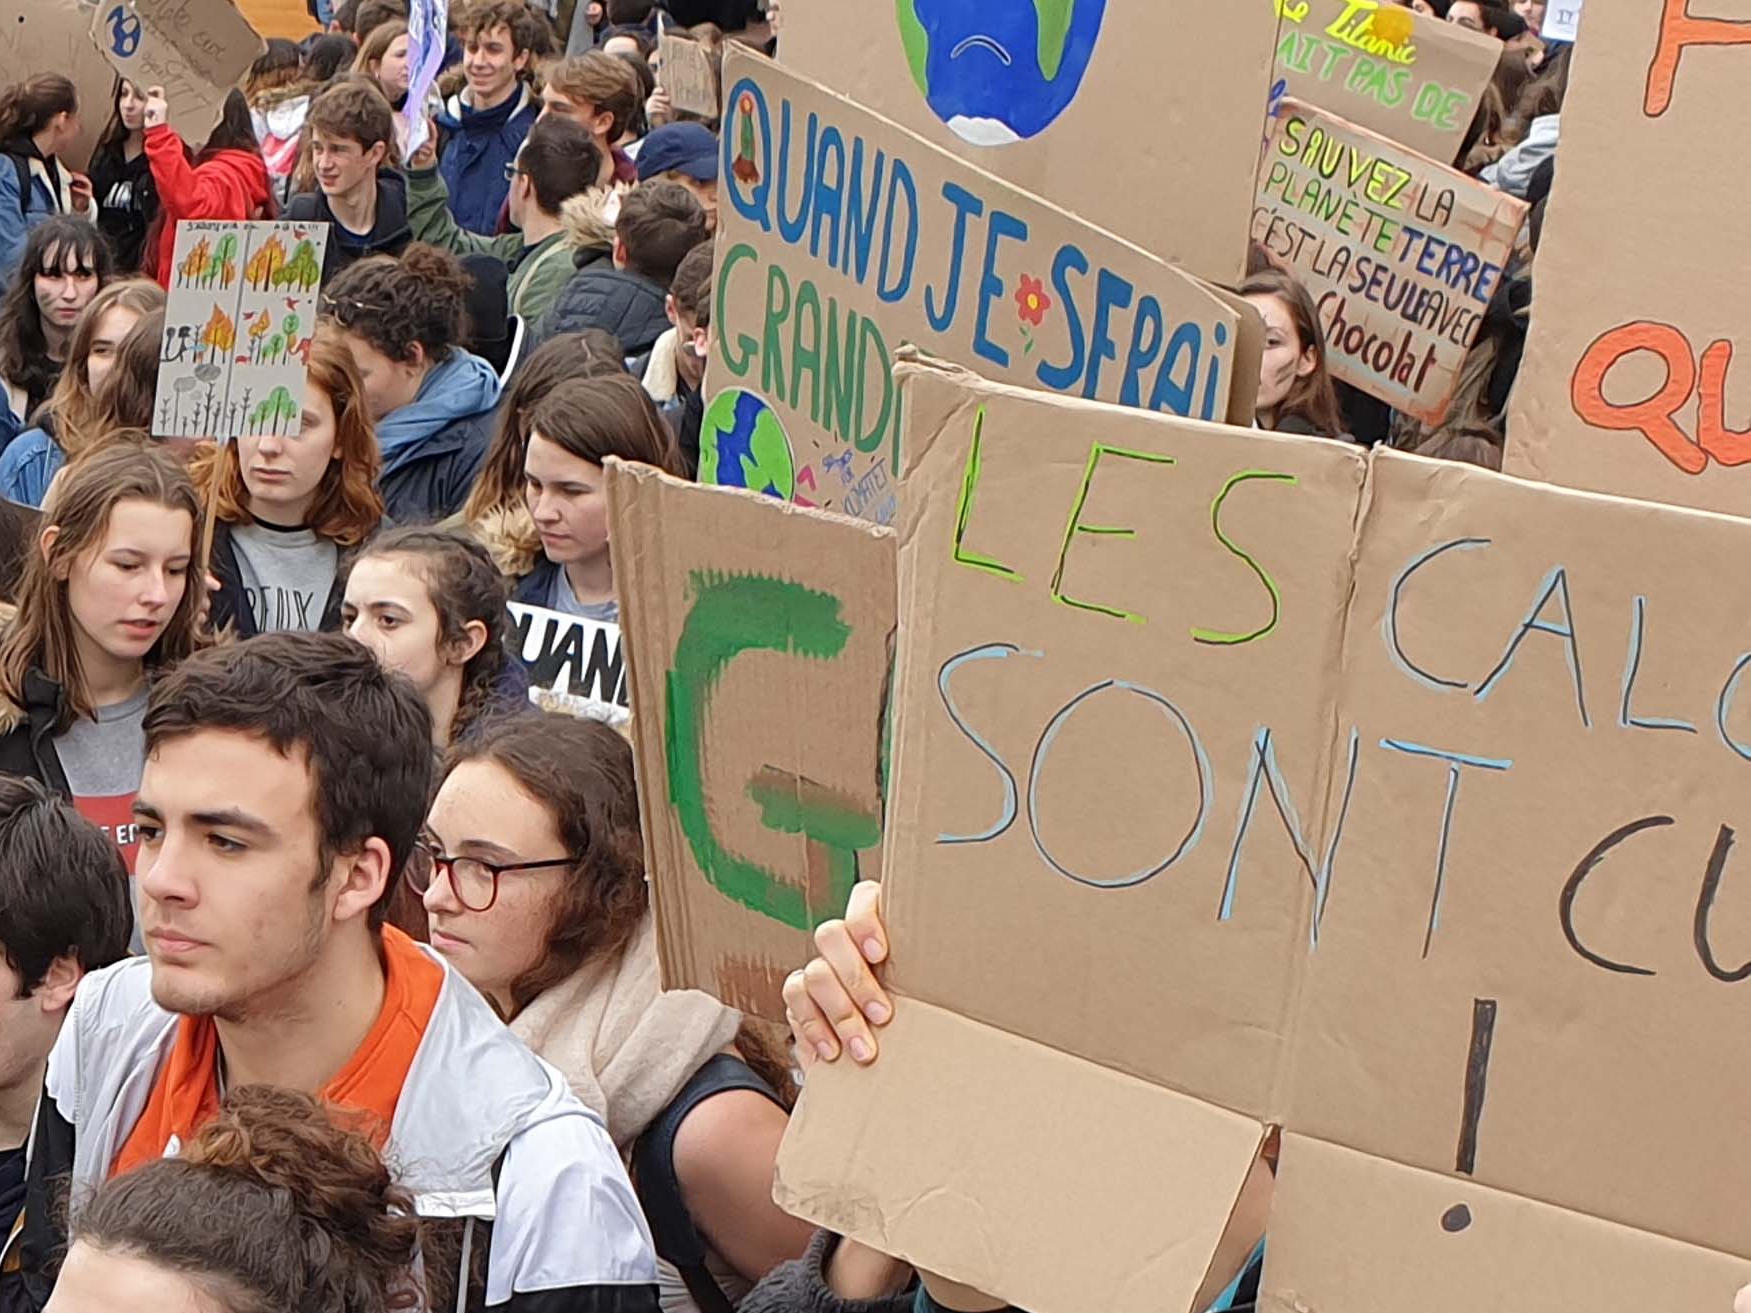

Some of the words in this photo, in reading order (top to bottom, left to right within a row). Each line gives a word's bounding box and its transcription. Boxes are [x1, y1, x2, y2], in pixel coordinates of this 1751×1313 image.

[1346, 56, 1413, 108] PAS
[1411, 80, 1469, 131] DE
[724, 77, 918, 303] QUAND
[924, 180, 1028, 368] JE
[1279, 117, 1412, 209] SAUVEZ
[1416, 183, 1455, 227] LA
[1311, 240, 1351, 285] LA
[1420, 290, 1483, 349] AVEC
[1398, 226, 1502, 304] TERRE
[954, 405, 1298, 645] LES
[935, 641, 1513, 960] SONT
